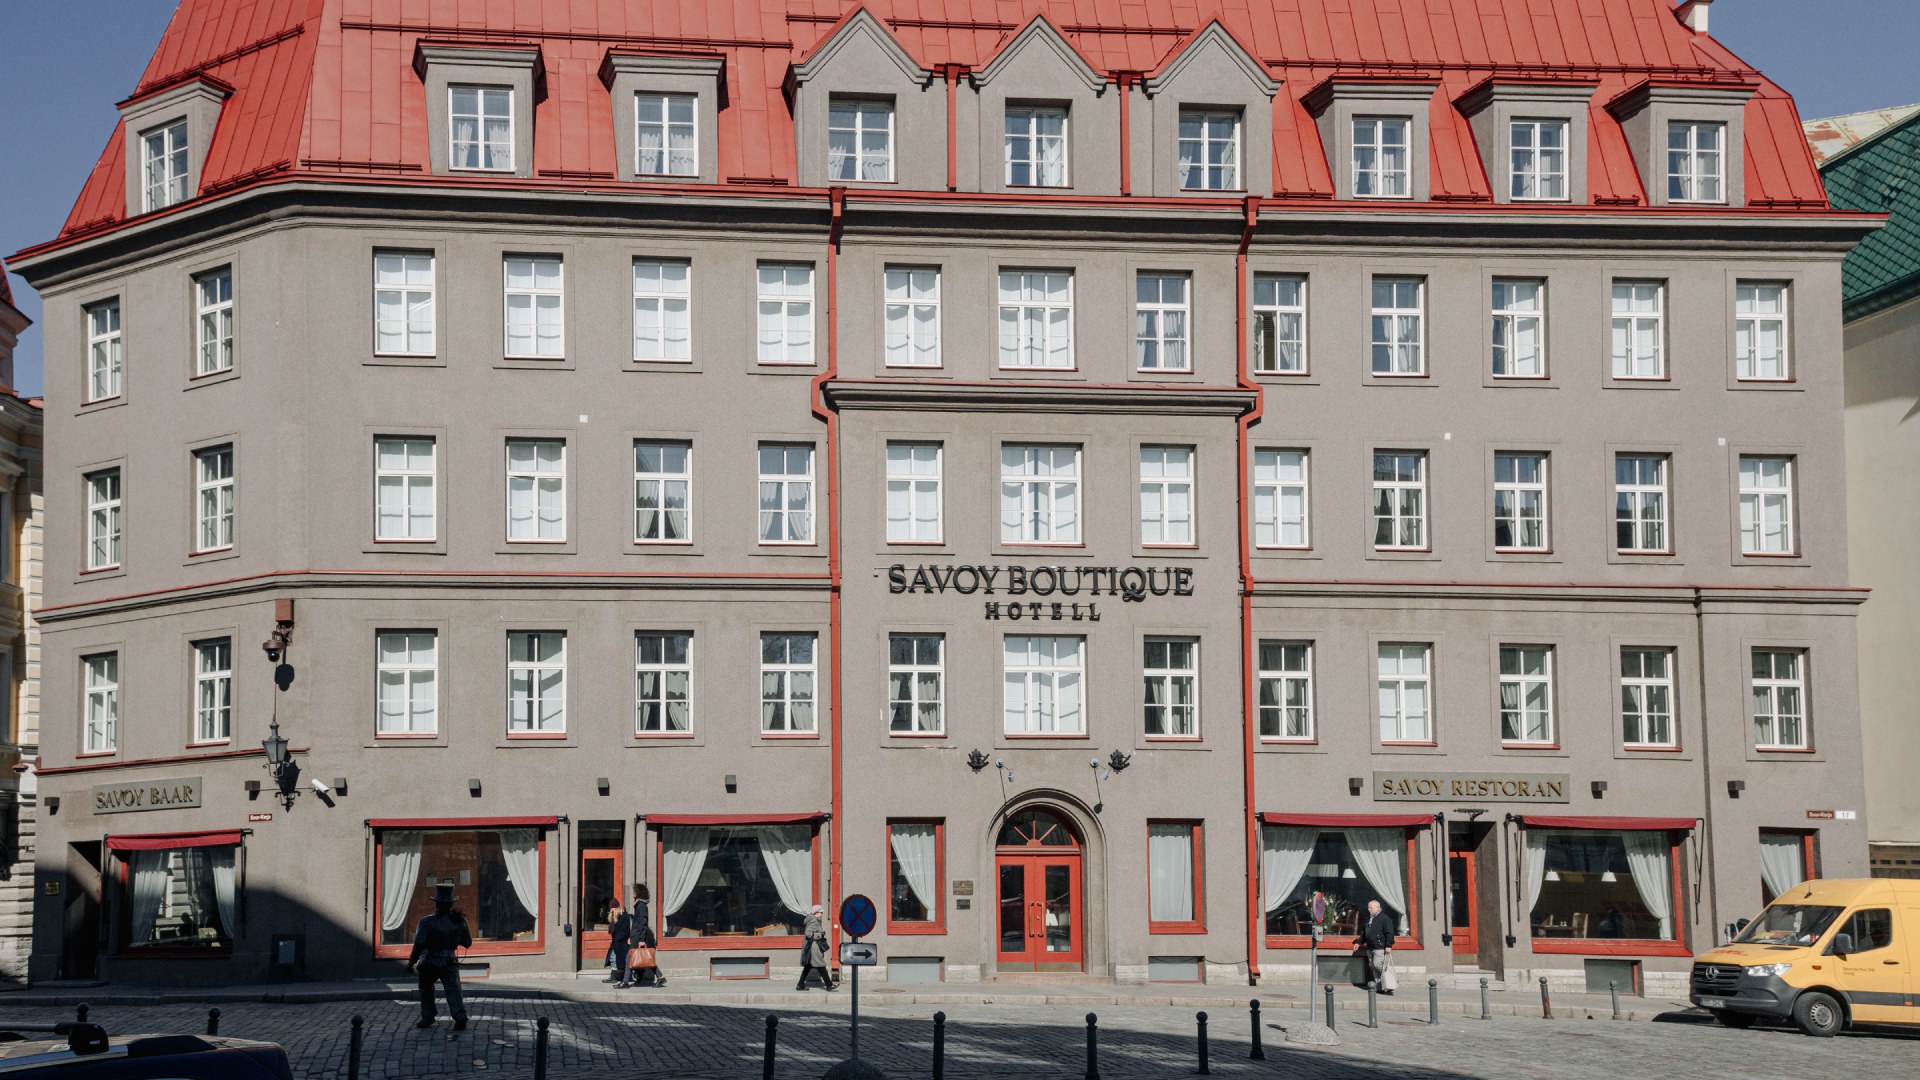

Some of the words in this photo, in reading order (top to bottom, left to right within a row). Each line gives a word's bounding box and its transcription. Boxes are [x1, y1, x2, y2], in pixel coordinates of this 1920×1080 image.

[888, 564, 999, 595] SAVOY
[1007, 565, 1194, 602] BOUTIQUE
[985, 602, 1101, 621] HOTELL
[96, 788, 144, 809] SAVOY
[150, 785, 193, 805] BAAR
[1382, 779, 1444, 796] SAVOY
[1451, 779, 1563, 798] RESTORAN
